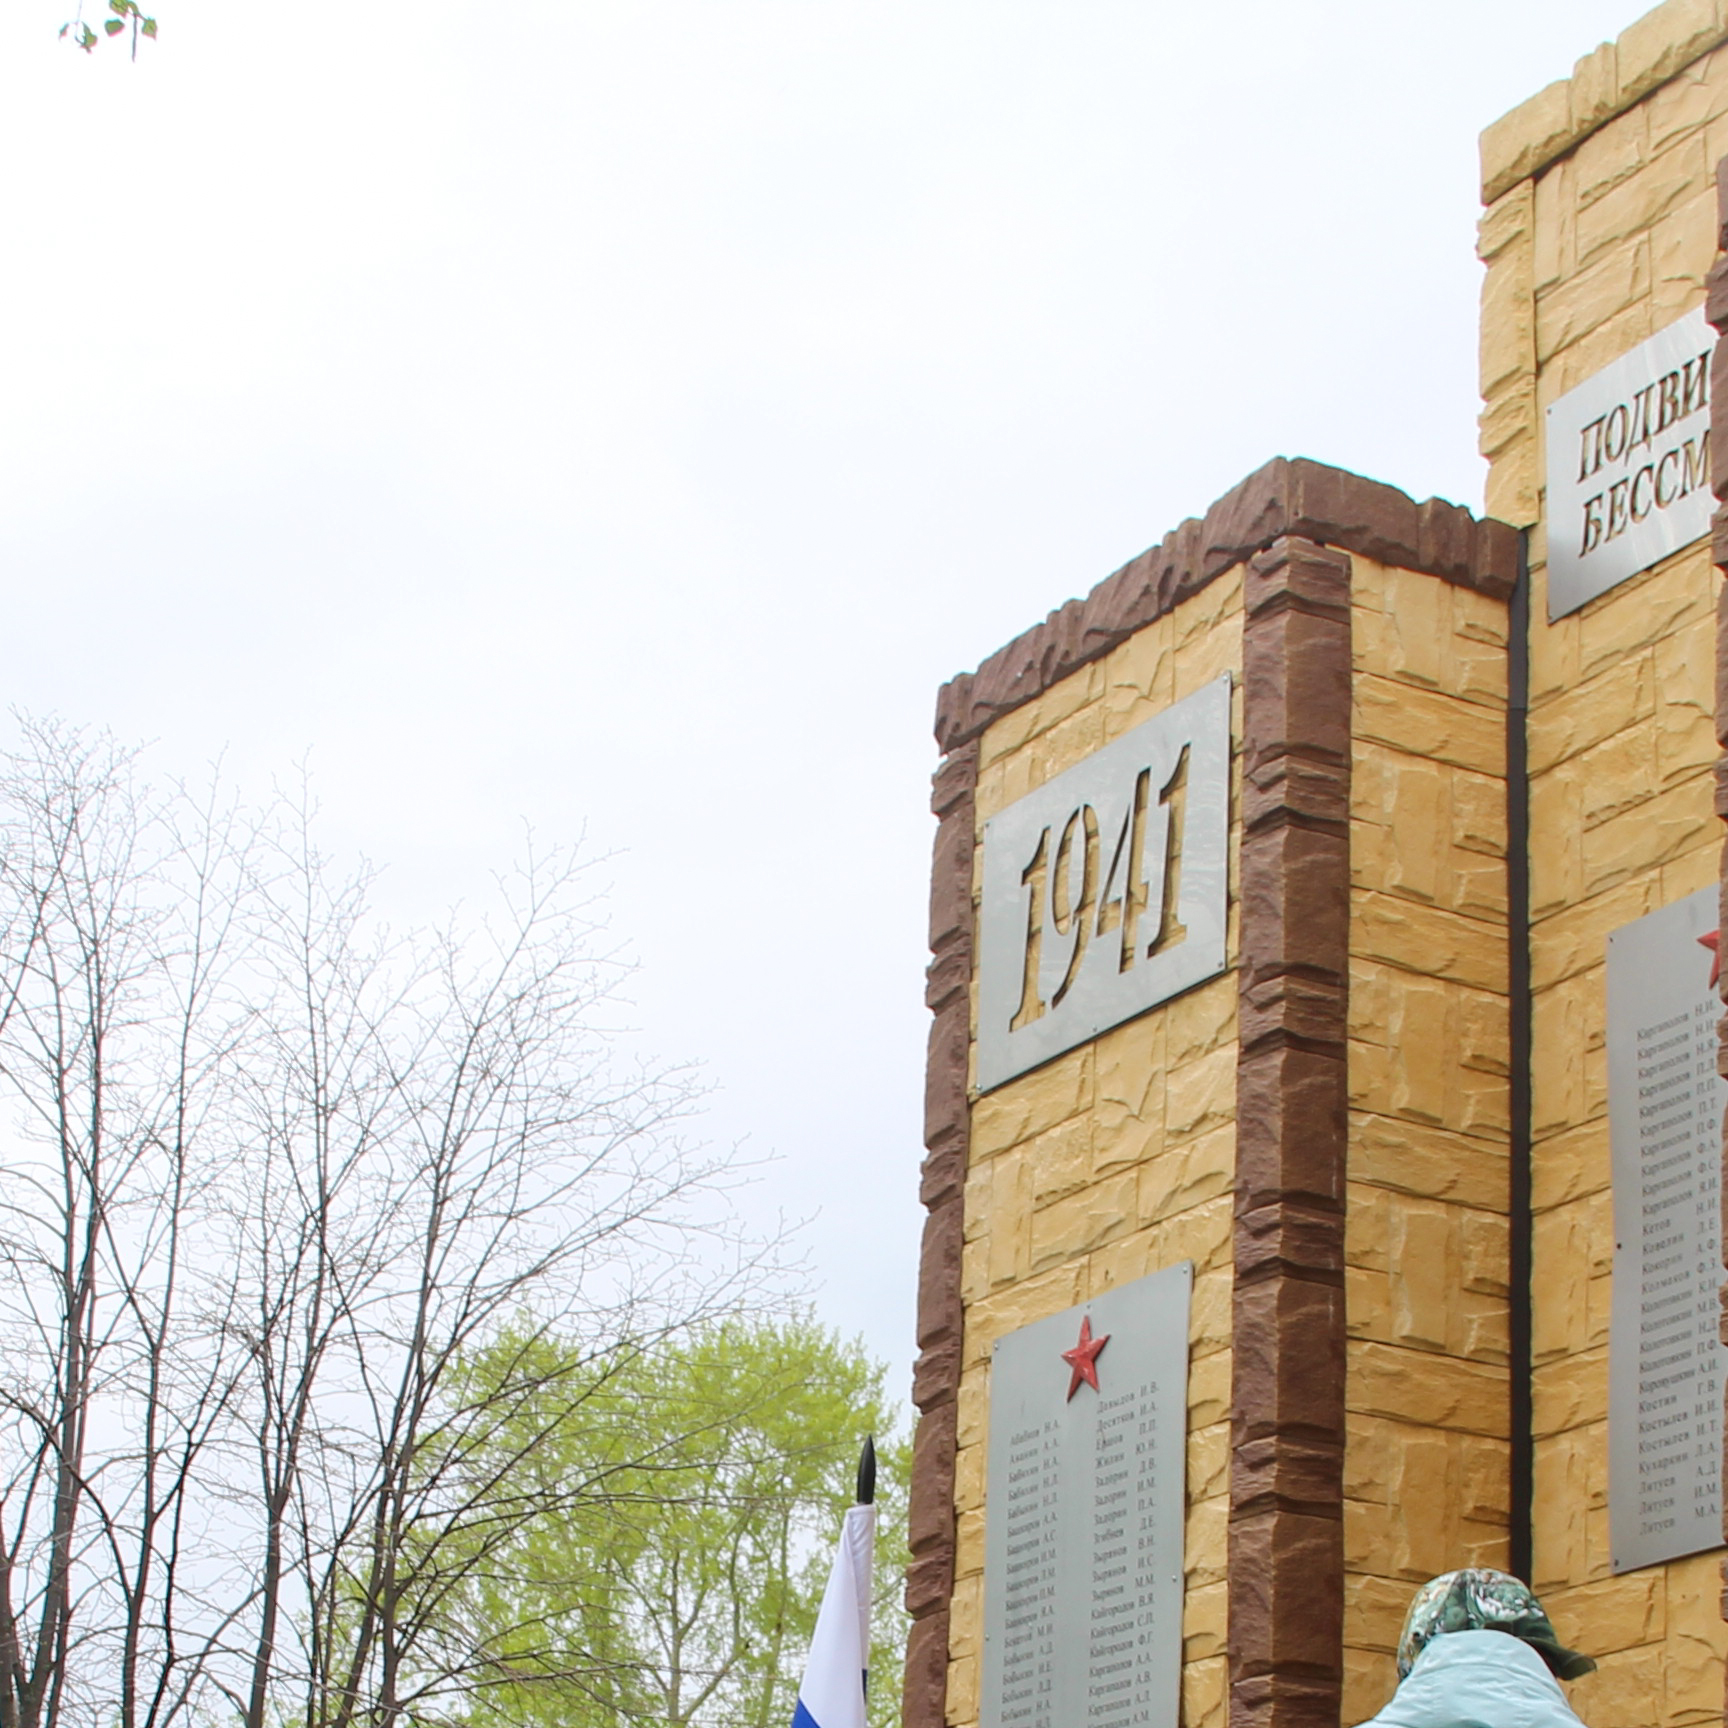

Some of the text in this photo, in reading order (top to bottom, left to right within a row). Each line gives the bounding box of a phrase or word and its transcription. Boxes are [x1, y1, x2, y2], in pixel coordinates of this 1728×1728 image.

[1576, 349, 1713, 484] ПОДВИ
[1578, 429, 1713, 559] БЕССМ
[1009, 742, 1192, 1034] 1941
